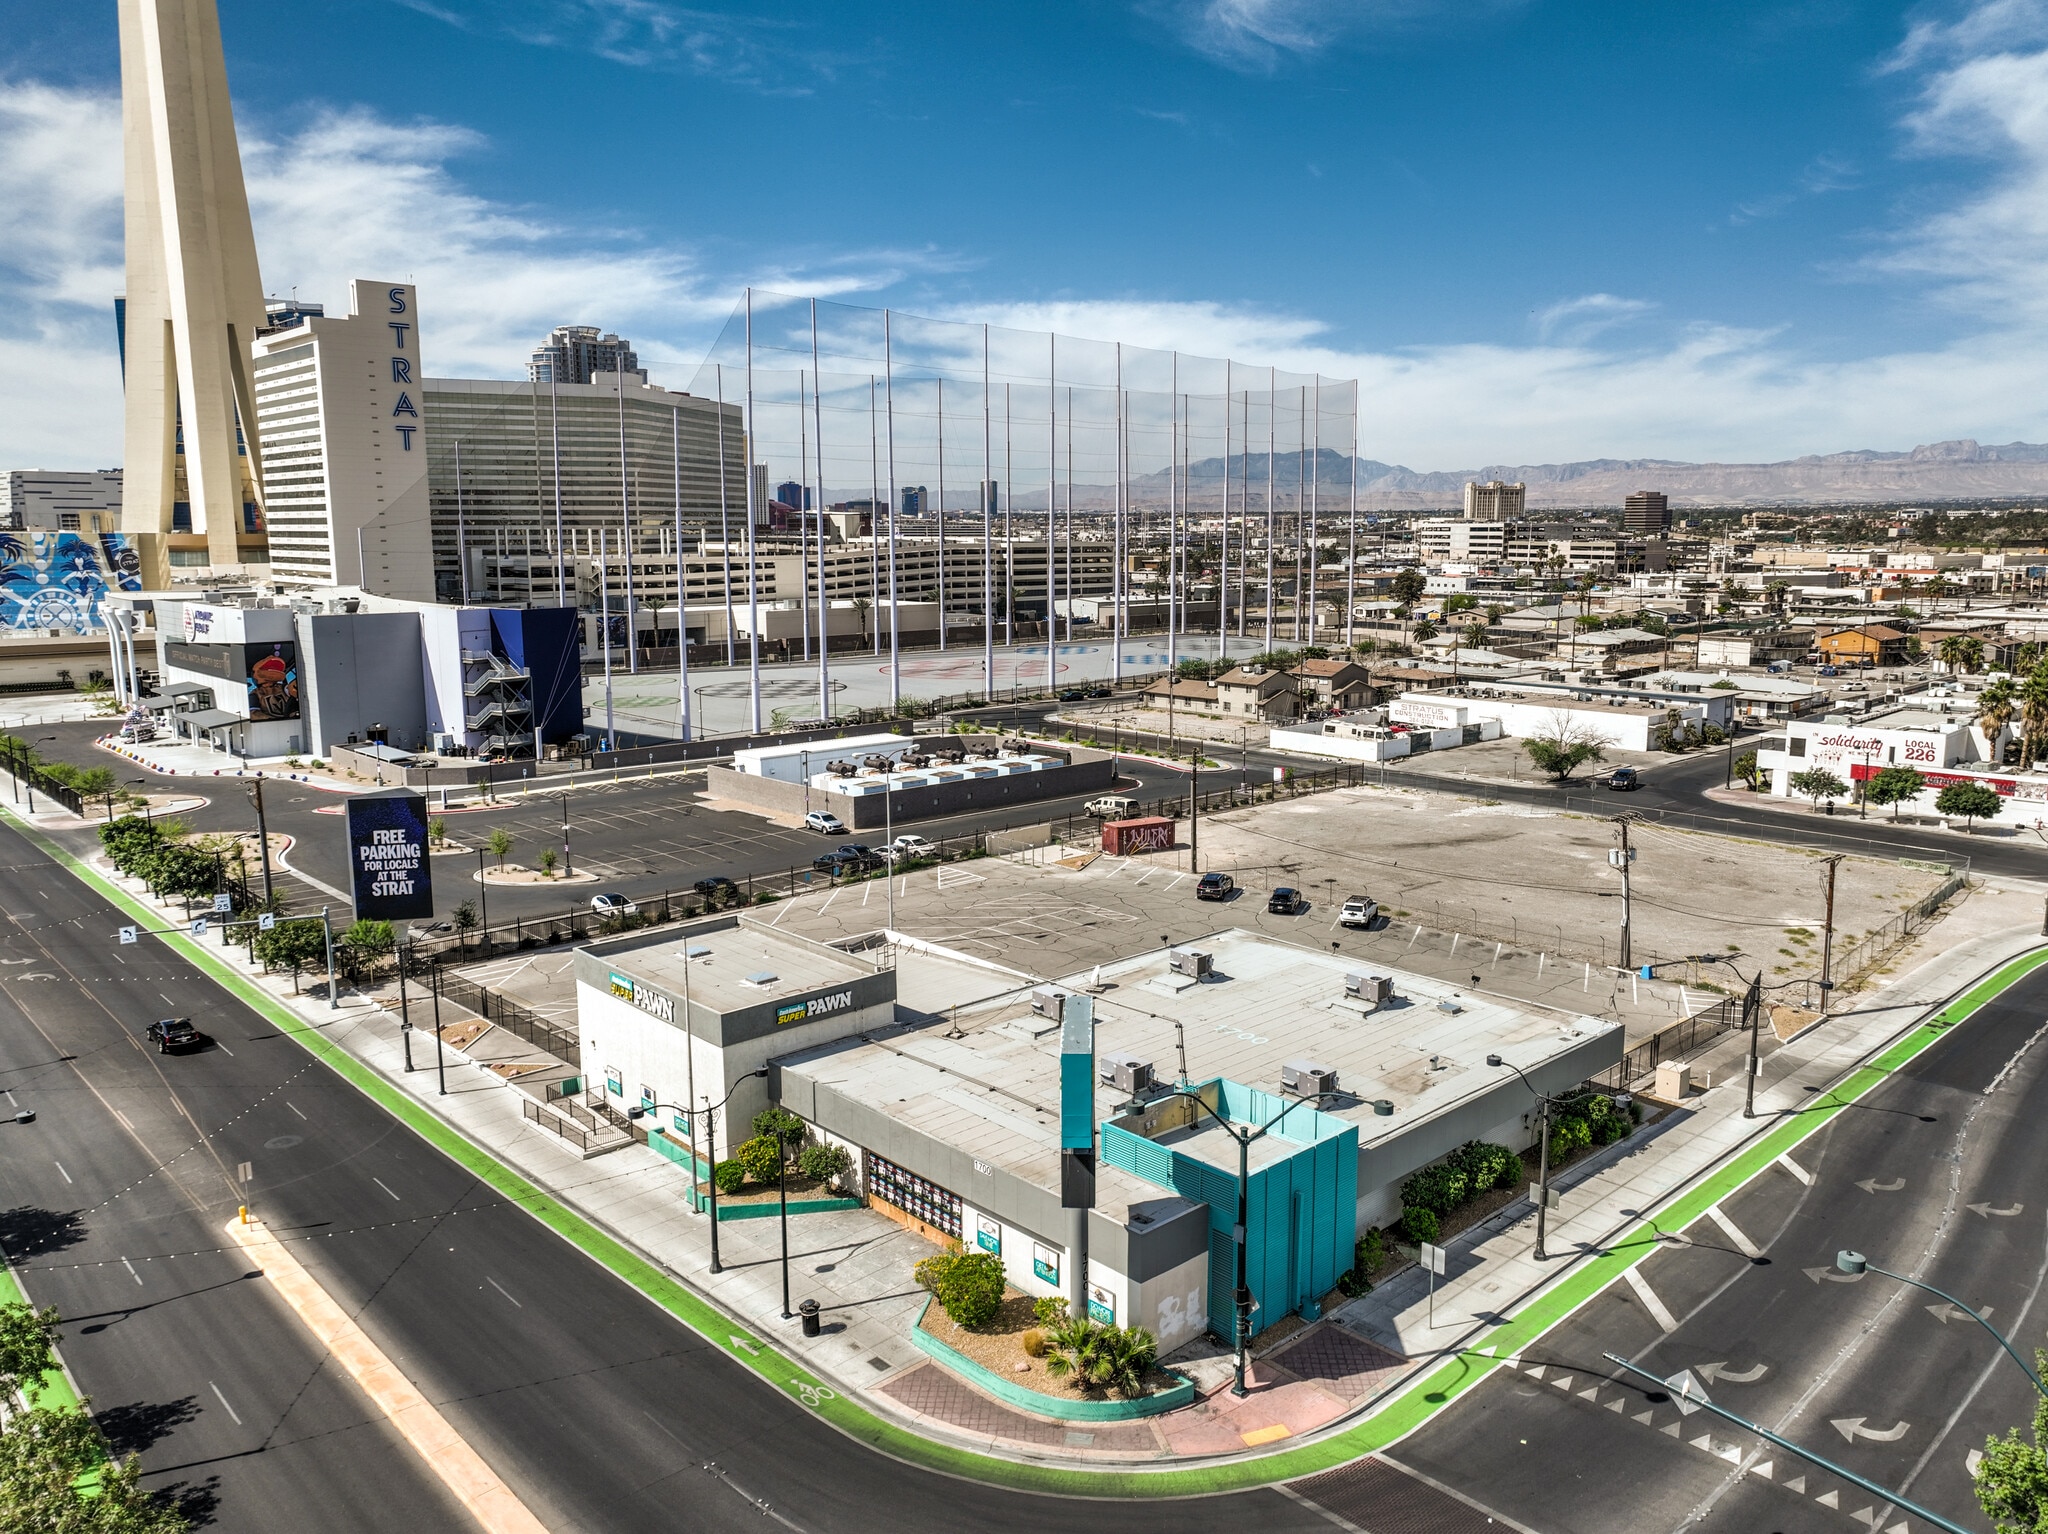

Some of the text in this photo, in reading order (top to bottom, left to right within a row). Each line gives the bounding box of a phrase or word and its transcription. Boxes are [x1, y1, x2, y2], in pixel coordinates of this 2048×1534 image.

[388, 287, 418, 451] STRAT
[1394, 709, 1449, 721] CONSTRUCTION
[1400, 703, 1444, 715] STRATUS
[1817, 734, 1883, 758] solidarity
[1905, 739, 1937, 750] LOCAL
[1904, 747, 1936, 762] 226
[372, 829, 407, 845] FREE
[360, 843, 421, 860] PARKING
[364, 859, 419, 871] FOR LOCALS
[377, 870, 408, 881] AT THE
[371, 880, 415, 897] STRAT
[216, 903, 229, 911] 25
[610, 983, 675, 1023] SUPER PAWN
[777, 990, 852, 1025] SUPER PAWN
[975, 1160, 992, 1175] 1700
